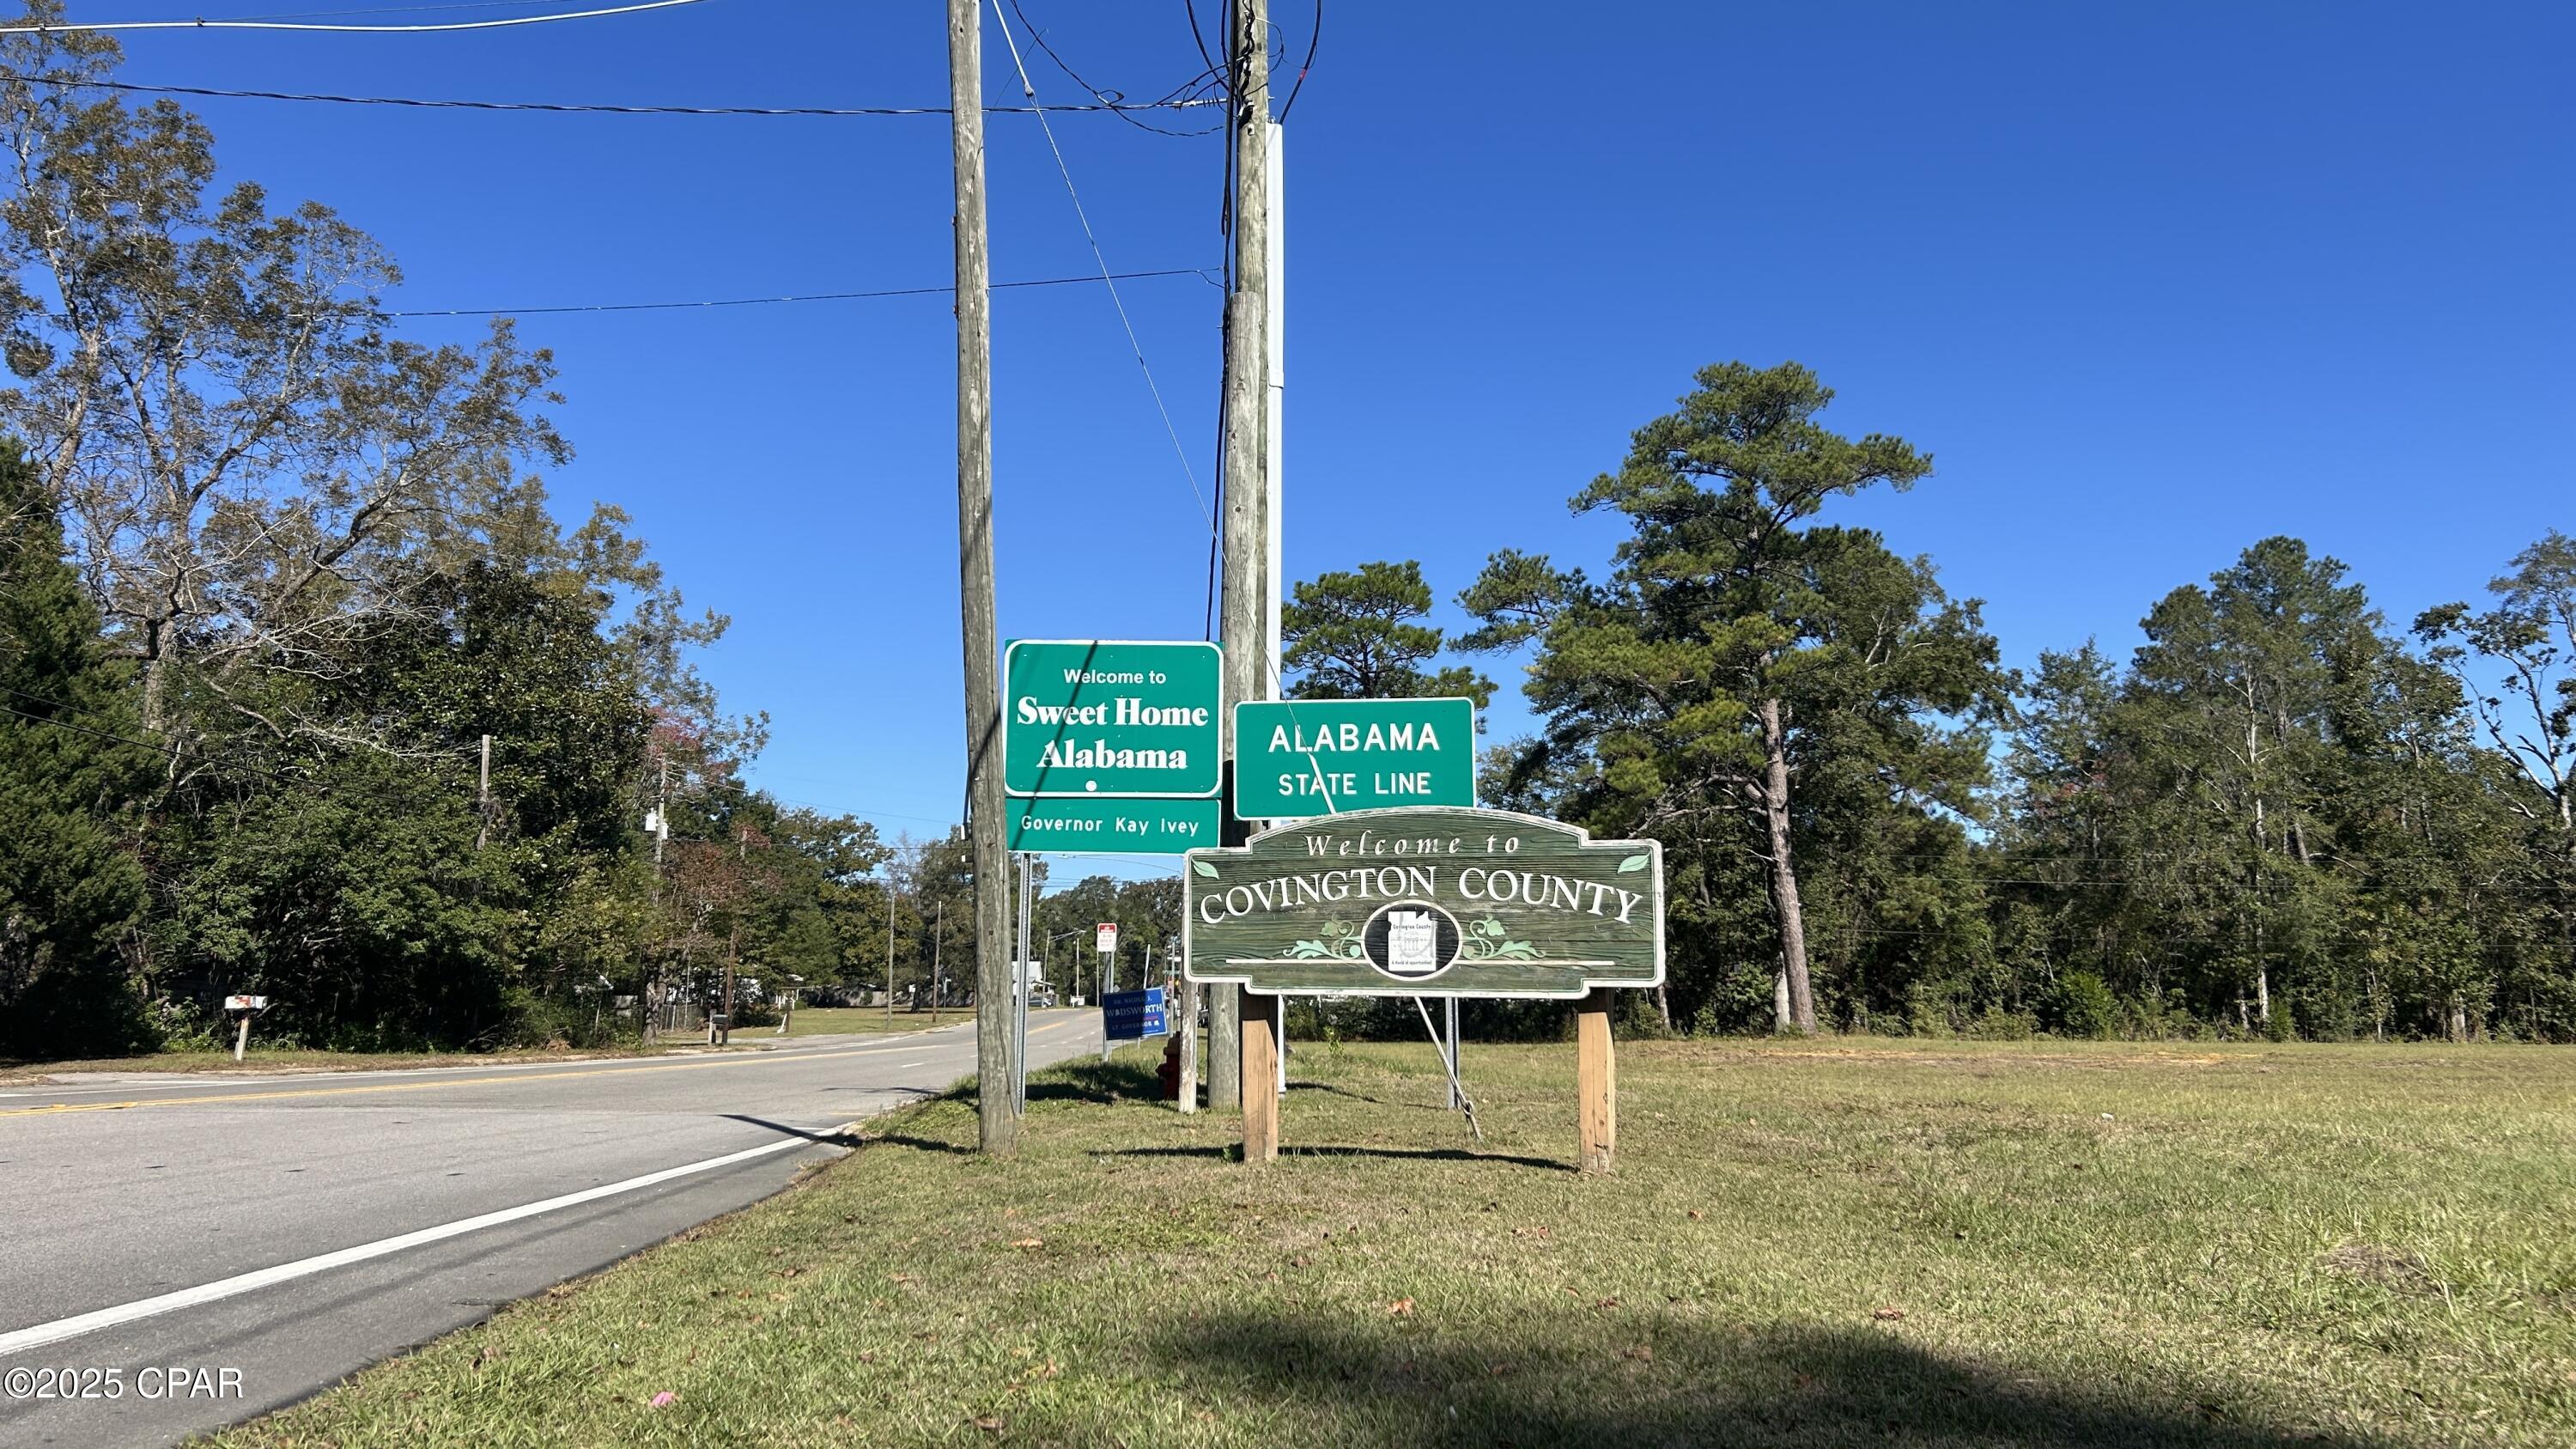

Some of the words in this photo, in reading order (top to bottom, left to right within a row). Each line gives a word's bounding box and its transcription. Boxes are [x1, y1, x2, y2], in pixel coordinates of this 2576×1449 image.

[1064, 668, 1144, 684] Welcome
[1149, 670, 1166, 684] to
[1017, 697, 1109, 725] Sweet
[1114, 697, 1209, 727] Home
[1268, 722, 1440, 752] ALABAMA
[1036, 739, 1188, 770] Alabama
[1279, 773, 1357, 795] STATE
[1375, 772, 1431, 795] LINE
[1022, 816, 1103, 831] Governor
[1115, 817, 1150, 836] Kay
[1161, 818, 1199, 837] Ivey
[1305, 830, 1460, 855] Welcome
[1486, 833, 1519, 853] to
[1200, 866, 1437, 924] COVINGTON
[1459, 867, 1643, 924] COUNTY
[1106, 1003, 1163, 1017] WADSWORTH
